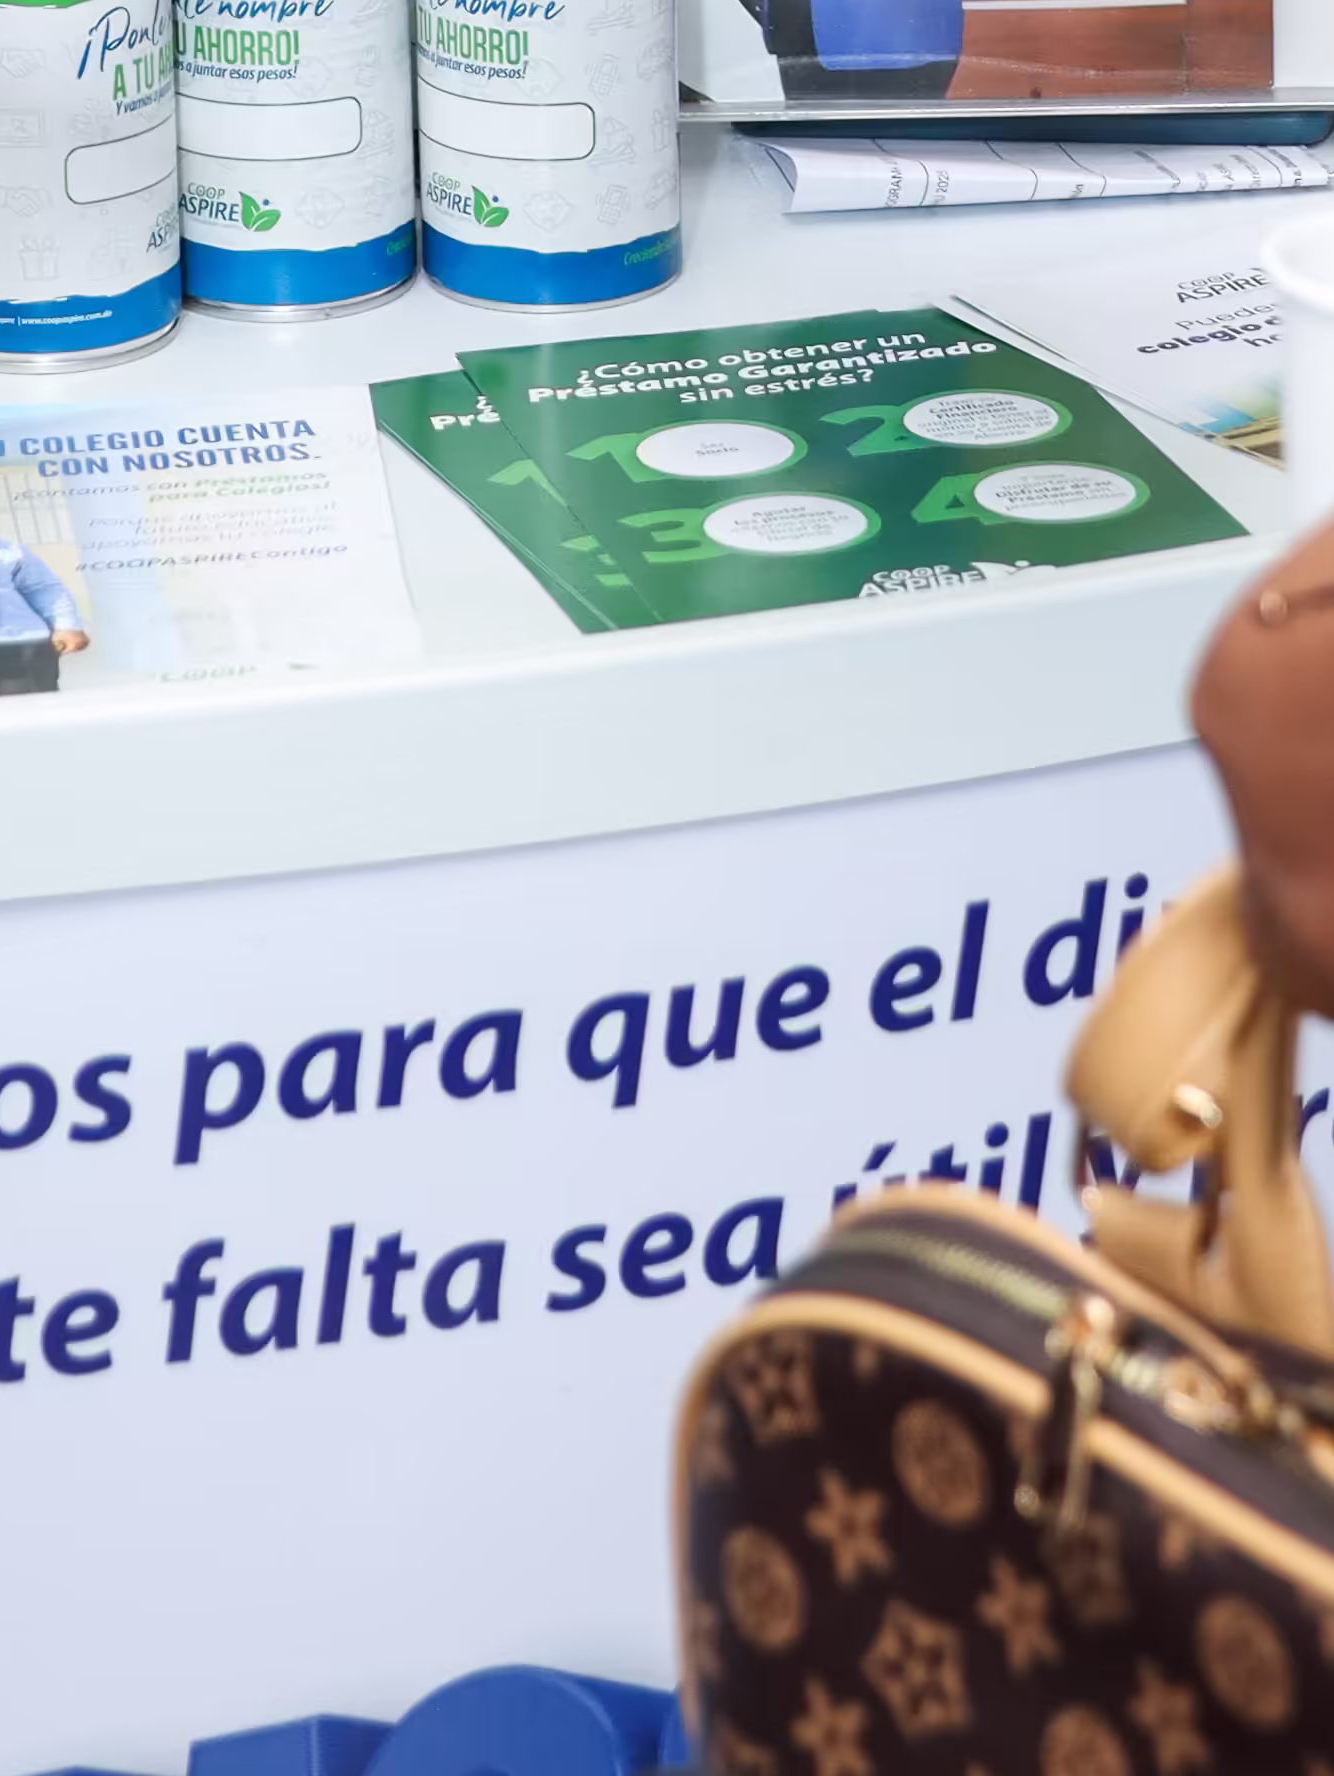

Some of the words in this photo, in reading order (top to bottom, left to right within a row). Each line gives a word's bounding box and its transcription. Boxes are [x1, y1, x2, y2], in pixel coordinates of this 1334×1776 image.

[193, 25, 300, 66] AHORRO!
[436, 16, 530, 66] AHORRO!
[113, 63, 127, 101] A
[133, 52, 155, 94] TU
[192, 60, 228, 80] juntar
[229, 66, 255, 80] esos
[256, 65, 298, 84] pesos!
[464, 61, 487, 77] esos
[488, 61, 527, 81] pesos!
[187, 182, 226, 199] COOP
[431, 171, 462, 190] COOP
[178, 193, 240, 222] ASPIRE
[426, 183, 472, 216] ASPIRE
[1176, 274, 1269, 304] ASPIRE
[1137, 323, 1262, 354] colegio
[527, 368, 728, 404] Préstamo
[736, 340, 998, 381] Garantizado
[577, 355, 709, 386] ¿Cómo
[718, 337, 868, 367] obtener
[877, 330, 926, 347] un
[679, 386, 734, 404] sin
[743, 368, 875, 397] estrés?
[20, 429, 165, 456] COLEGIO
[177, 419, 316, 445] CUENTA
[38, 450, 110, 478] CON
[123, 441, 322, 472] NOSOTROS.
[147, 479, 189, 492] con
[194, 470, 328, 490] Préstamos
[149, 488, 209, 503] para
[217, 478, 331, 498] Colegios!
[872, 563, 951, 583] COOP
[172, 1005, 526, 1168] para
[565, 964, 831, 1110] que
[866, 897, 991, 1036] el
[1021, 870, 1162, 1007] di
[162, 1221, 508, 1367] falta
[543, 1193, 787, 1316] sea
